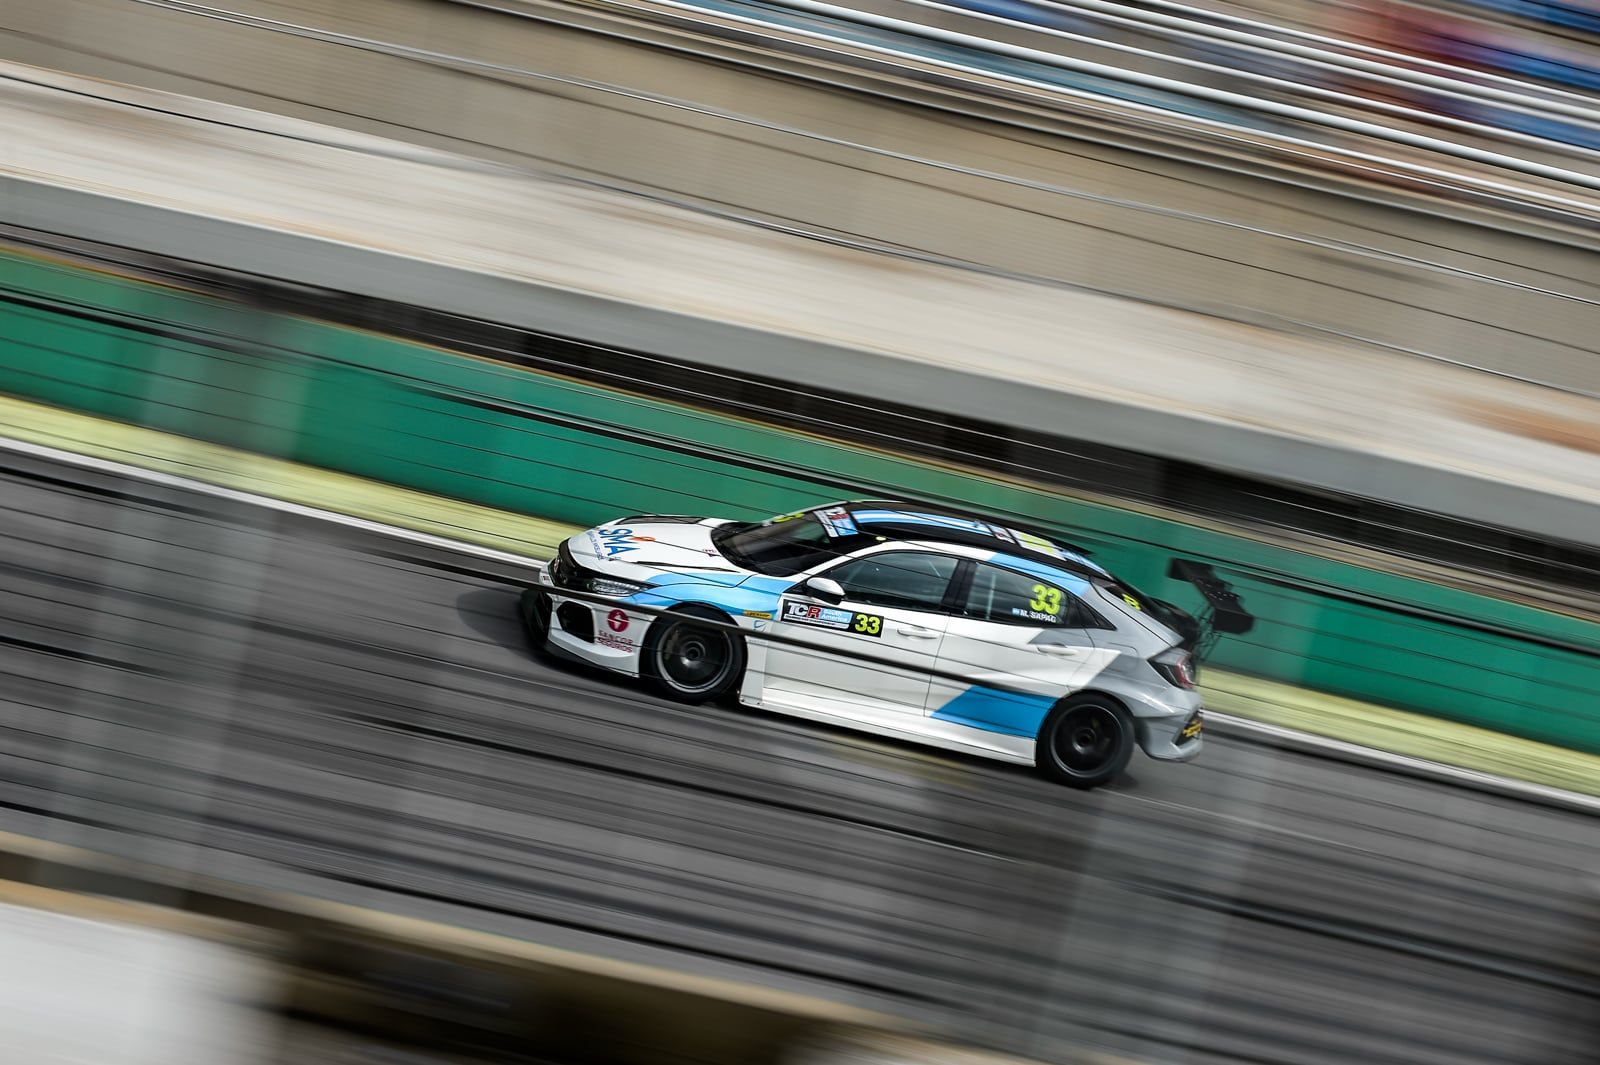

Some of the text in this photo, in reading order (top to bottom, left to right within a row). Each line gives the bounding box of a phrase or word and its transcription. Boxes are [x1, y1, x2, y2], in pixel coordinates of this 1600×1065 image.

[598, 528, 641, 556] SMA
[1030, 584, 1061, 614] 33
[788, 602, 821, 619] TCR
[855, 614, 880, 634] 33
